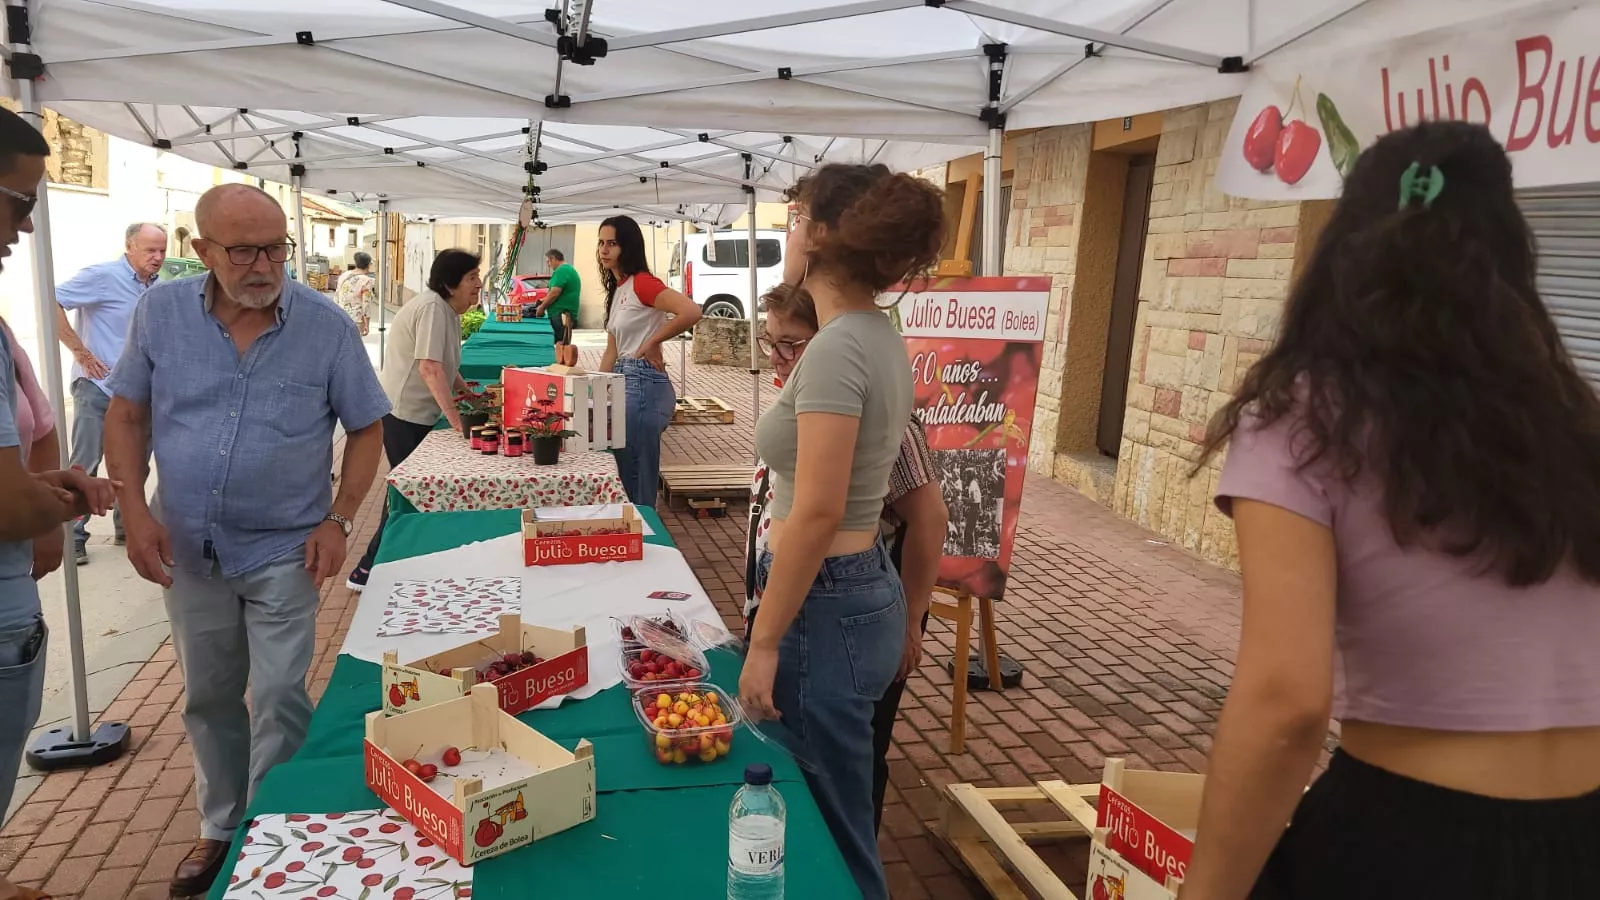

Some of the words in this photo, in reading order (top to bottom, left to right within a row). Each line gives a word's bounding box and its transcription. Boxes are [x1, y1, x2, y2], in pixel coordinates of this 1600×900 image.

[906, 298, 942, 329] Julio
[946, 298, 996, 330] Buesa
[1001, 309, 1040, 336] (Bolea)
[912, 351, 937, 385] 60
[532, 544, 572, 563] Julio
[578, 543, 628, 557] Buesa
[525, 667, 575, 700] Buesa
[370, 758, 400, 800] Julio
[404, 783, 448, 840] Buesa
[475, 845, 499, 859] Cereza
[499, 840, 509, 850] de
[509, 834, 529, 846] Bolea
